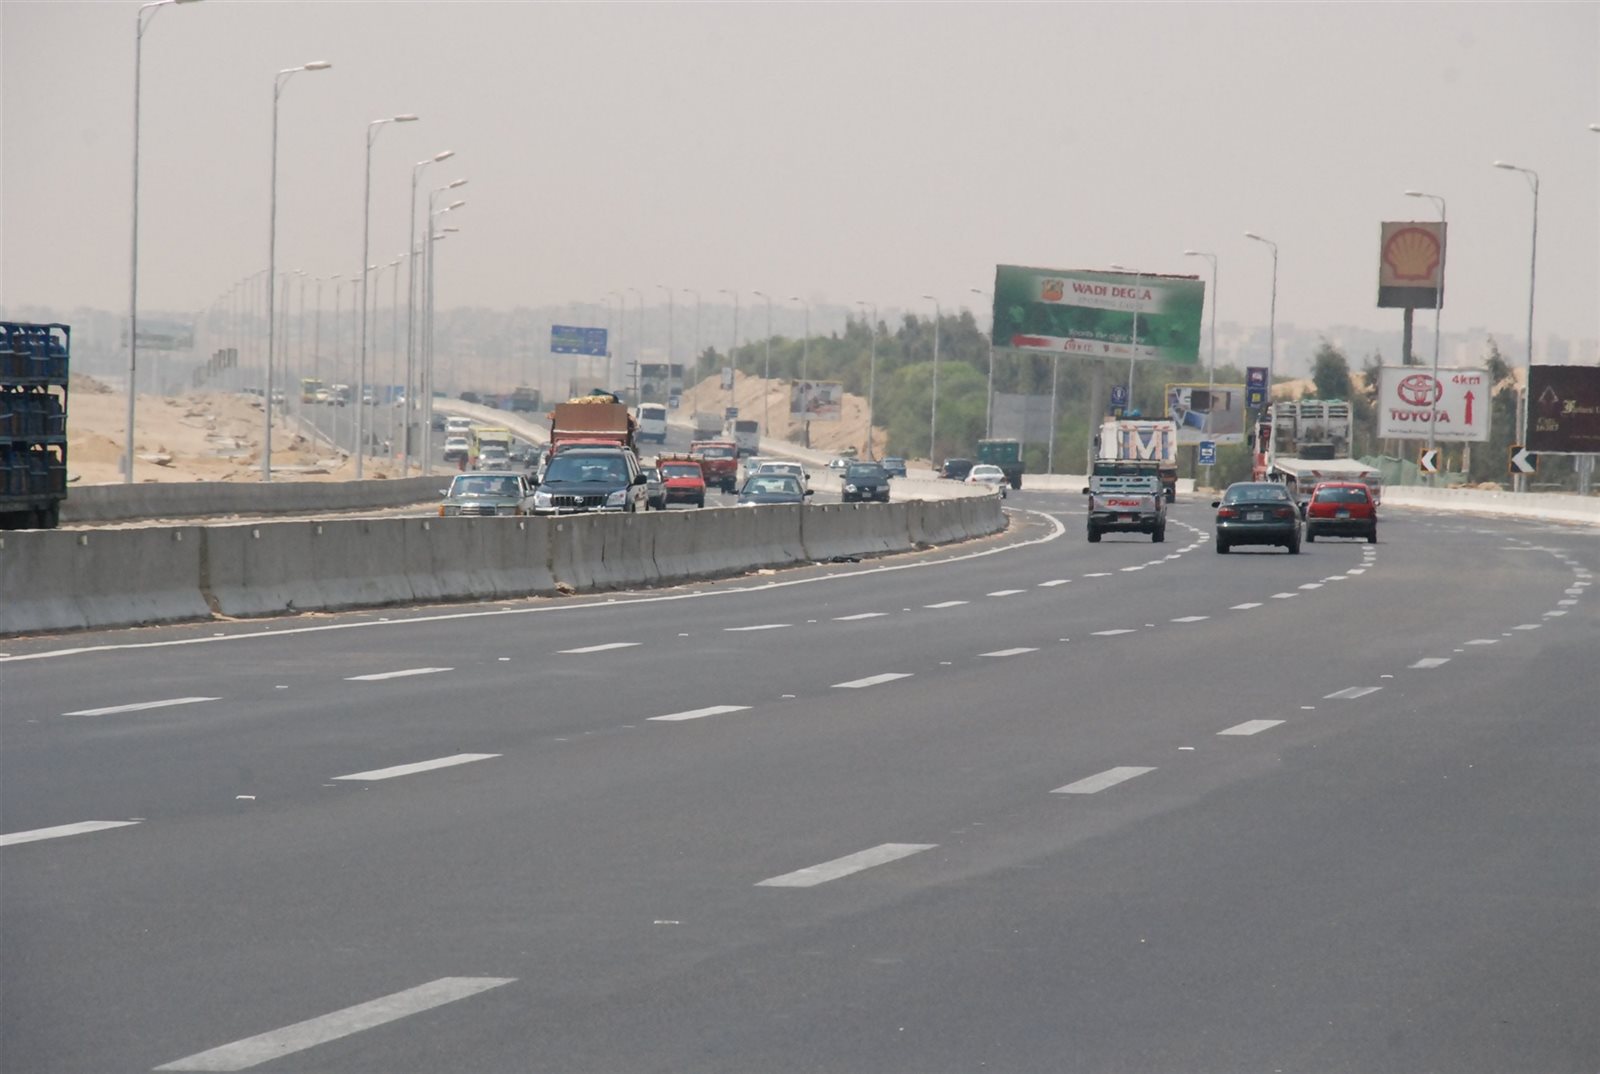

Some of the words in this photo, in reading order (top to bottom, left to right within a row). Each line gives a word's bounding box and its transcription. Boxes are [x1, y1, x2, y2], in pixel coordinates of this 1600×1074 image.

[1073, 283, 1108, 296] WADI
[1452, 375, 1480, 384] 4km
[1390, 410, 1450, 422] TOYOTA
